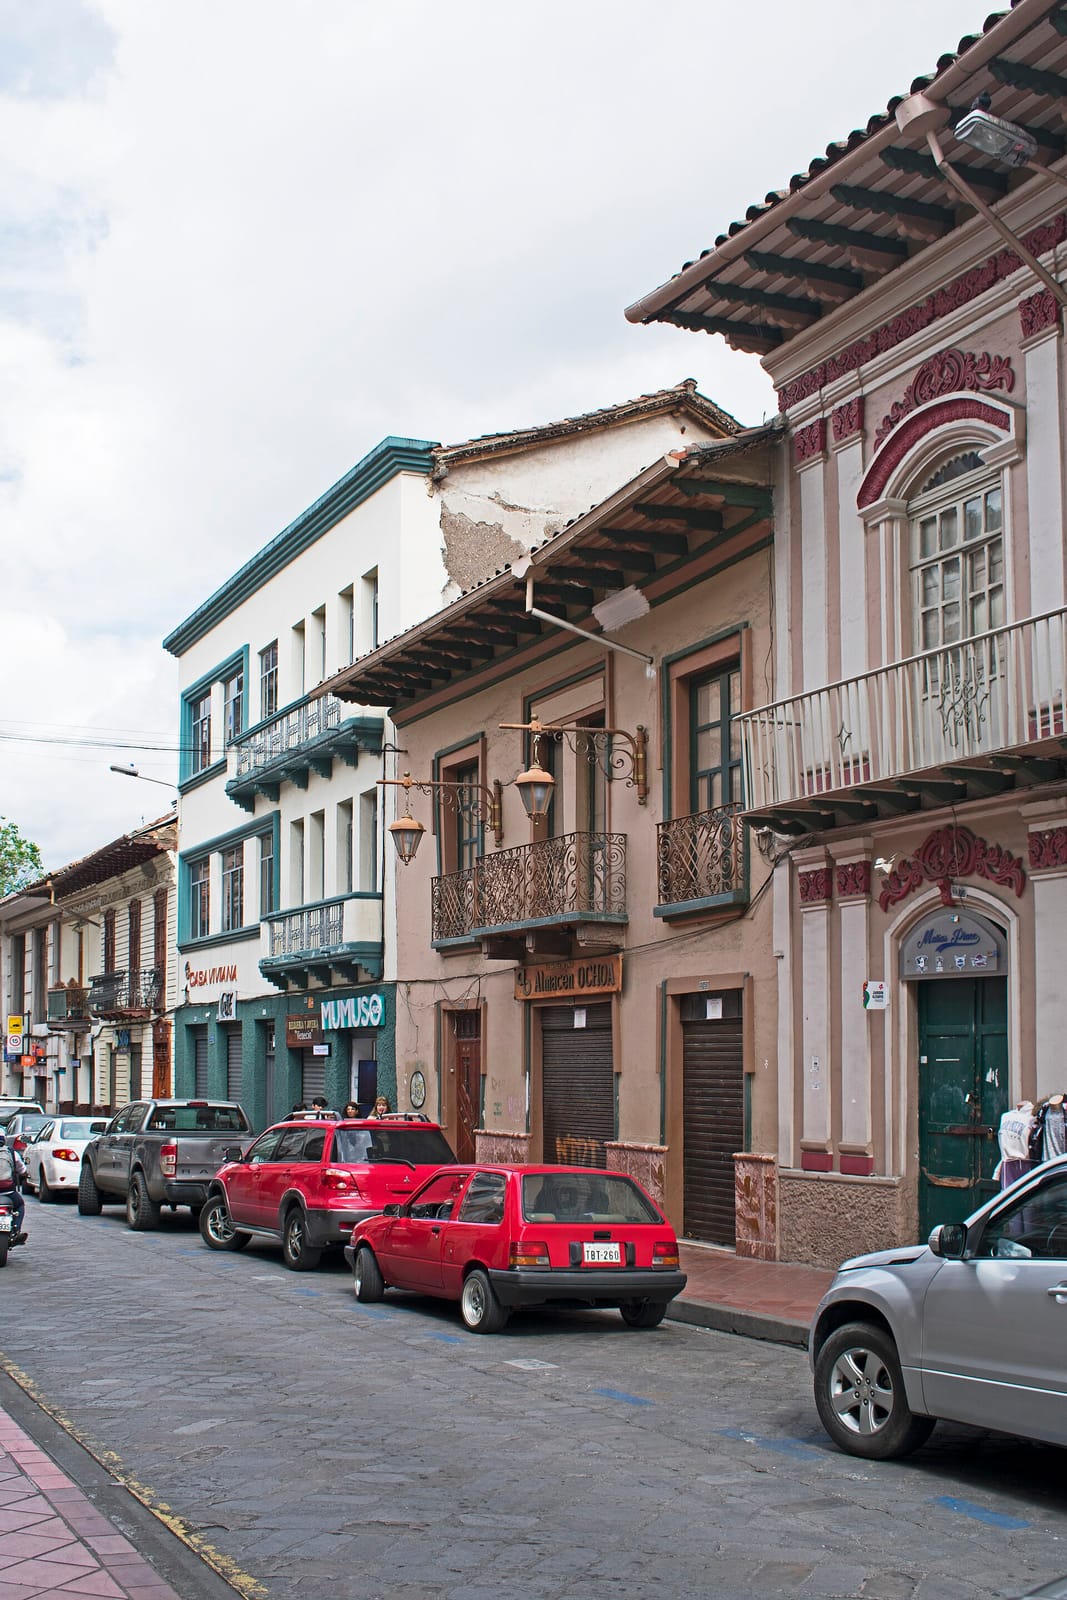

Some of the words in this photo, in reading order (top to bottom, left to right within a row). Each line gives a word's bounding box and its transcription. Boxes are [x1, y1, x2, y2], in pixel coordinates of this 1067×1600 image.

[190, 970, 208, 988] CASA
[208, 964, 237, 985] VIVIANA
[535, 970, 575, 992] Almacen
[577, 962, 615, 989] OCHOA
[321, 993, 382, 1030] MUMUSO
[586, 1250, 619, 1260] TBT-260
